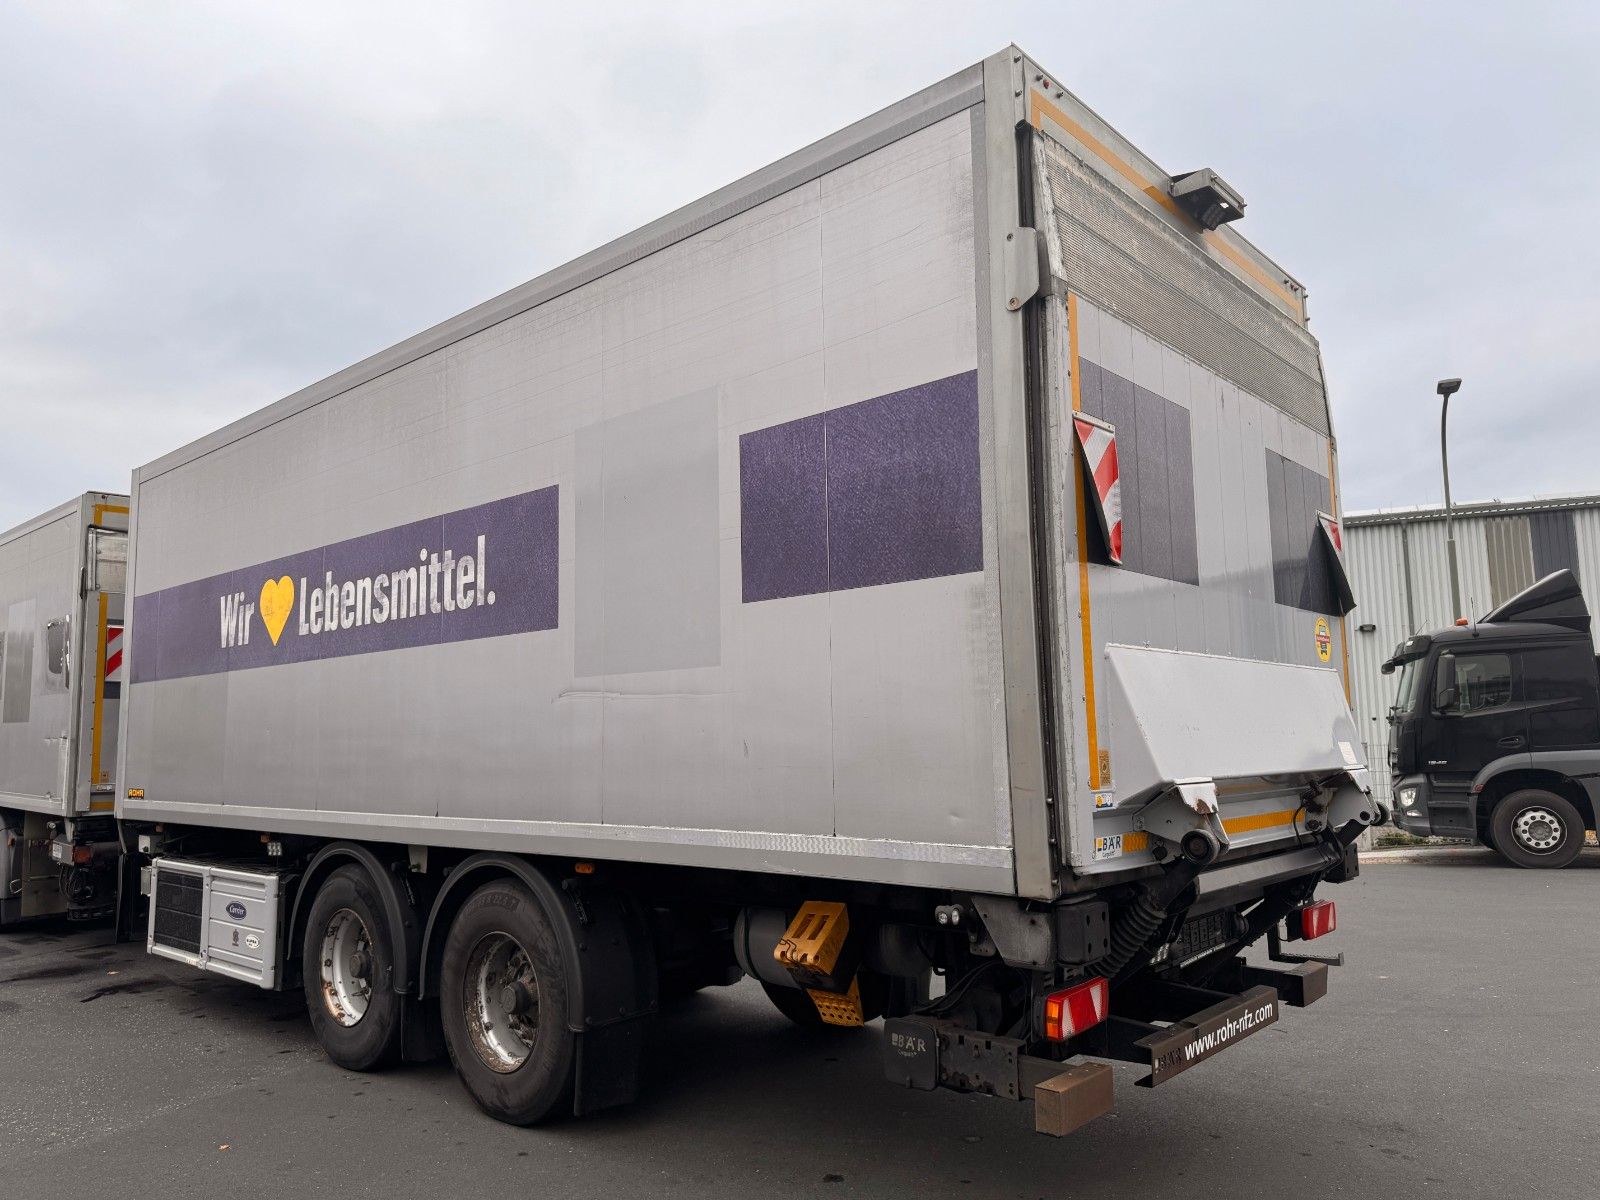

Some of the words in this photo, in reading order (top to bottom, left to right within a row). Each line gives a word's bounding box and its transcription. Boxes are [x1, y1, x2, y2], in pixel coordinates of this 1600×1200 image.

[220, 591, 254, 648] Wir
[298, 534, 496, 636] Lebensmittel.
[1103, 835, 1121, 851] BÄR
[898, 1033, 927, 1052] BÄR
[1184, 1002, 1273, 1061] www.rohr-nfz.com
